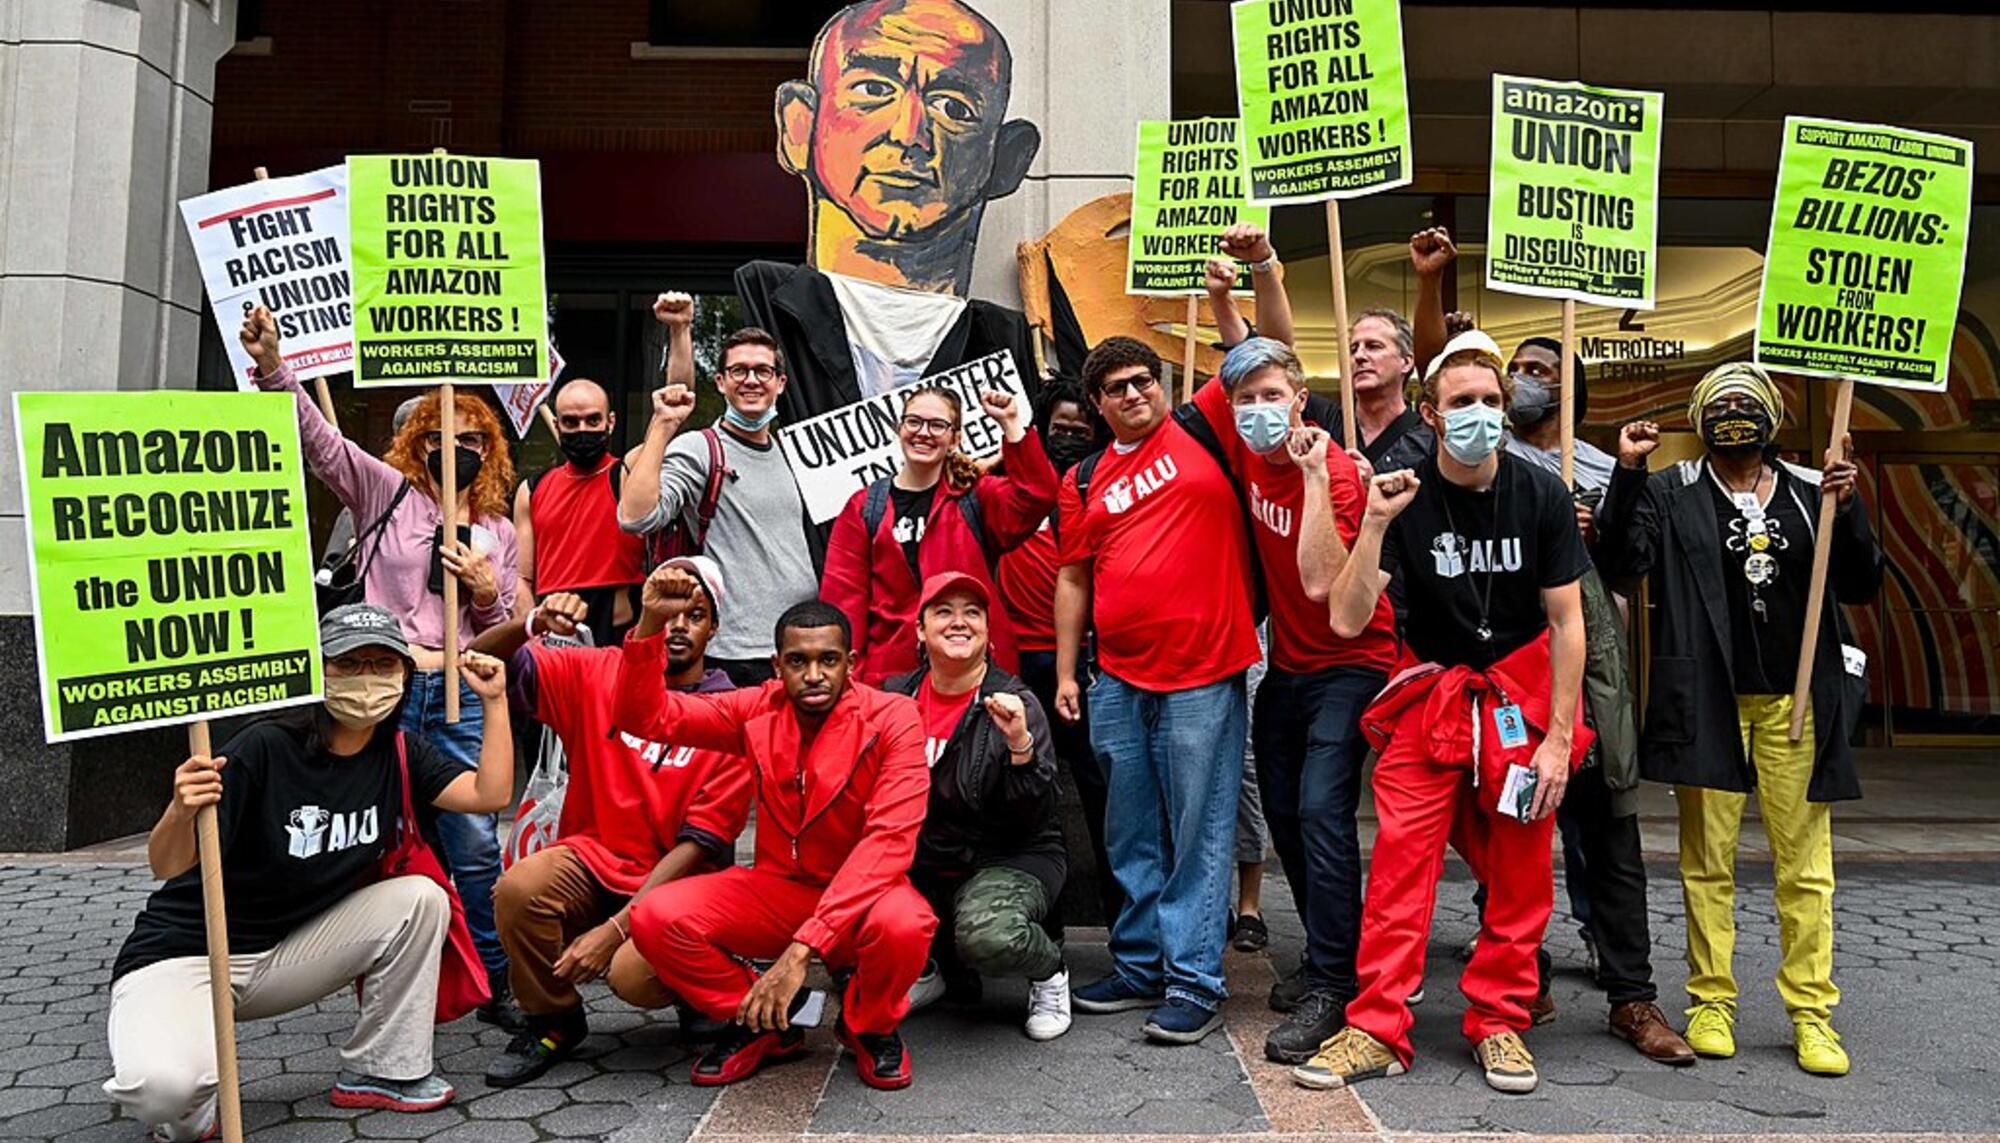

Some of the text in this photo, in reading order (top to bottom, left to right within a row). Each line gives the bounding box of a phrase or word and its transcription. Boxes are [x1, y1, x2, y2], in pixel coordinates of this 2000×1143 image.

[1269, 0, 1353, 27] UNION
[1267, 20, 1361, 60] RIGHTS
[1268, 53, 1374, 93] FOR ALL
[1270, 88, 1369, 124] AMAZON
[1506, 87, 1640, 124] amazon:
[1168, 122, 1236, 146] UNION
[1257, 121, 1371, 160] WORKERS
[1512, 118, 1632, 175] UNION
[1799, 127, 1845, 146] SUPPORT
[391, 158, 488, 189] UNION
[1162, 148, 1238, 173] RIGHTS
[1253, 150, 1399, 182] WORKERS ASSEMBLY
[1159, 175, 1244, 201] FOR ALL
[1269, 169, 1386, 196] AGAINST RACISM
[1821, 157, 1936, 201] BEZOS'
[387, 194, 496, 224] RIGHTS
[1156, 206, 1237, 228] AMAZON
[1518, 183, 1634, 231] BUSTING
[1793, 198, 1949, 246] BILLIONS:
[228, 206, 314, 248] FIGHT
[387, 229, 509, 260] FOR ALL
[1571, 223, 1583, 240] IS
[225, 237, 342, 287] RACISM
[1135, 264, 1192, 275] WORKERS
[1505, 233, 1646, 276] DISGUSTING!
[1806, 247, 1913, 295] STOLEN
[259, 269, 350, 312] UNION
[385, 268, 501, 296] AMAZON
[1146, 277, 1194, 287] AGAINST
[1836, 288, 1876, 310] FROM
[369, 305, 503, 333] WORKERS
[1777, 303, 1927, 354] WORKERS!
[363, 343, 534, 358] WORKERS ASSEMBLY
[381, 360, 518, 375] AGAINST RACISM
[1804, 350, 1856, 365] ASSEMBLY
[1856, 356, 1894, 370] AGAINST
[1896, 361, 1932, 374] RACISM
[42, 422, 282, 478] Amazon:
[1133, 453, 1178, 500] ALU
[52, 488, 293, 541] RECOGNIZE
[1470, 538, 1522, 572] ALU
[74, 551, 285, 611] the UNION
[125, 609, 229, 663] NOW
[62, 656, 308, 704] WORKERS ASSEMBLY
[93, 682, 288, 727] AGAINST RACISM
[327, 805, 379, 852] ALU
